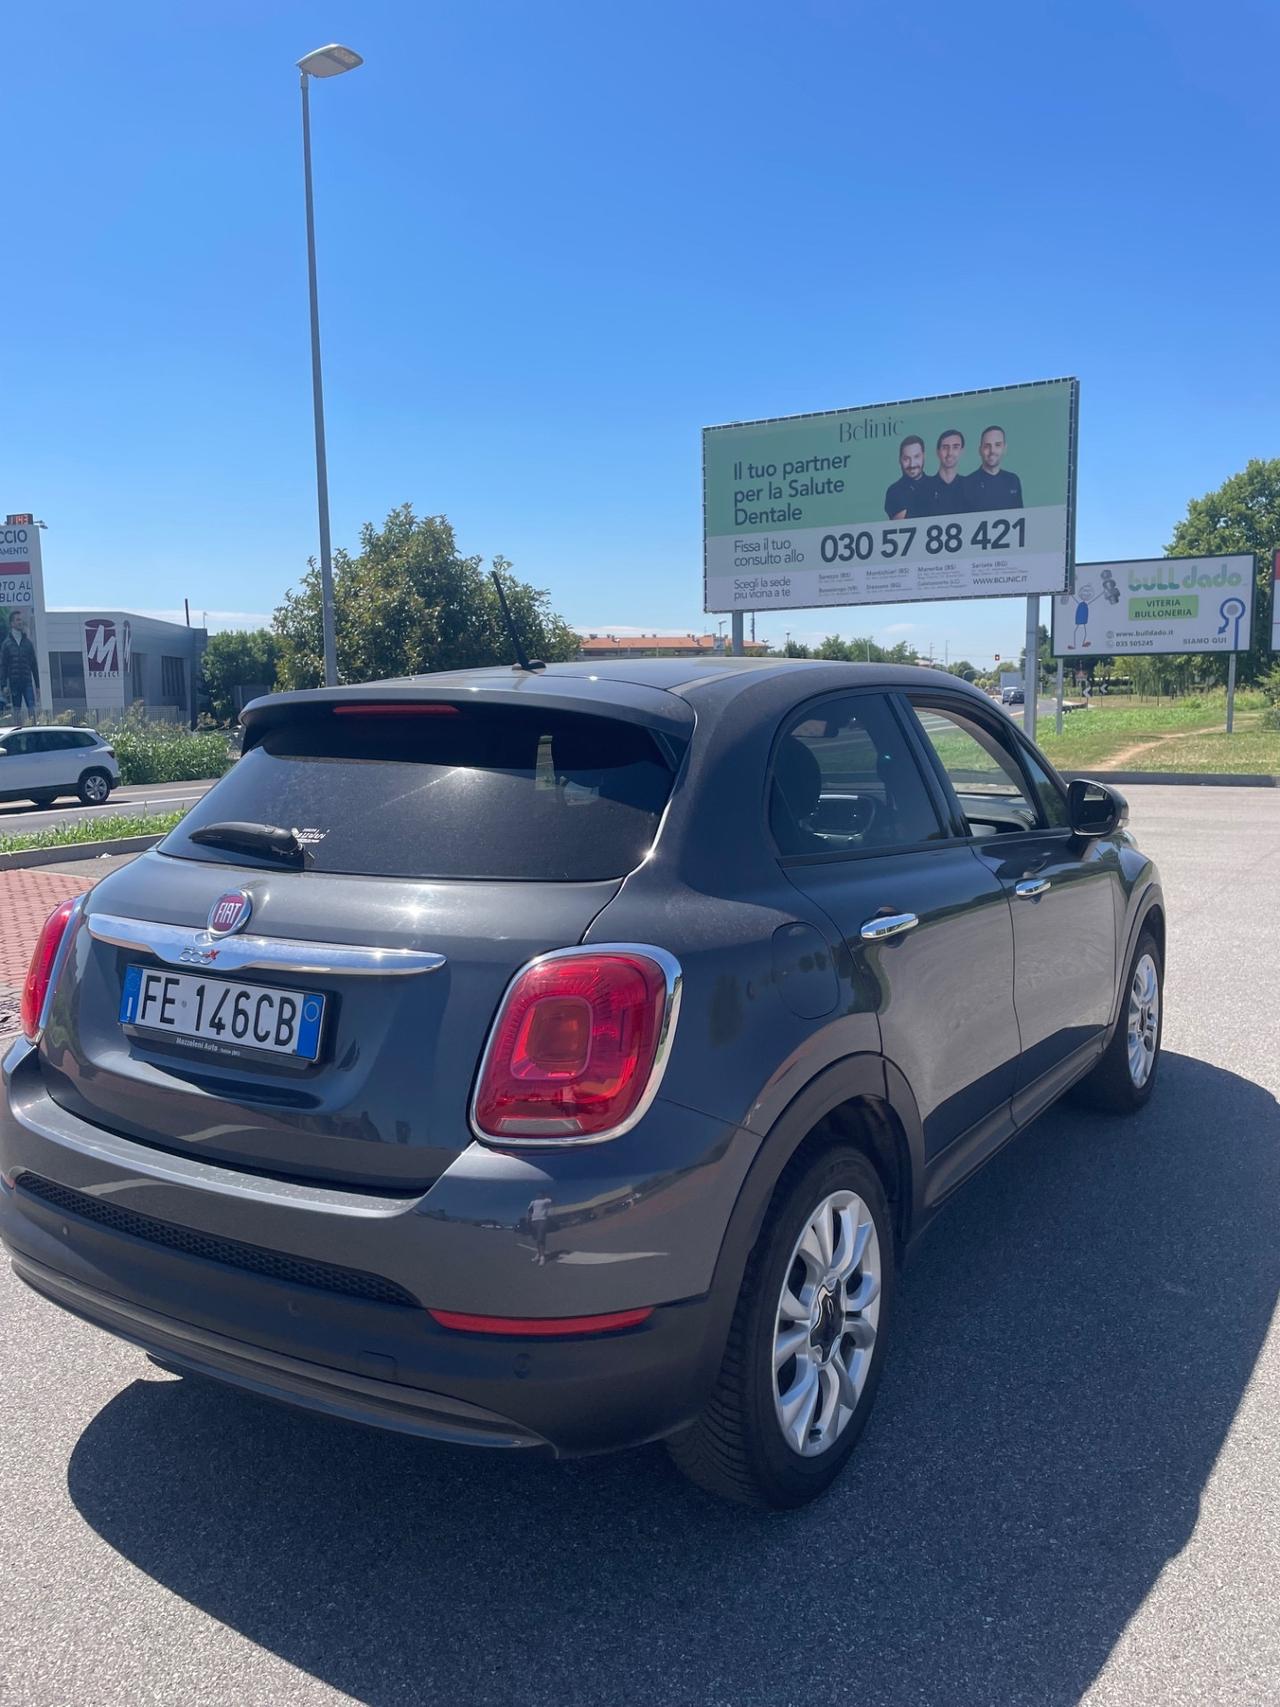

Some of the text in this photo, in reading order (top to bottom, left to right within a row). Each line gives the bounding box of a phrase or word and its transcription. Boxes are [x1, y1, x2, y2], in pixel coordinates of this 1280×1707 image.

[839, 416, 904, 443] Bclinic
[734, 455, 851, 480] Il tuo partner
[734, 477, 845, 508] per la Salute
[734, 503, 803, 526] Dentale
[734, 538, 792, 553] Fissa il tuo
[820, 517, 1026, 563] 030 57 88 421
[734, 549, 805, 567] consulto allo
[0, 580, 32, 591] TO AL
[761, 578, 768, 587] la
[769, 577, 791, 587] sede
[782, 586, 791, 597] te
[1146, 599, 1182, 607] VITERIA
[1134, 609, 1193, 618] BULLONERIA
[1115, 629, 1174, 638] www.bulldado.it
[214, 902, 242, 924] FIAT
[141, 974, 298, 1047] FE 146CB
[204, 1042, 219, 1053] Auto
